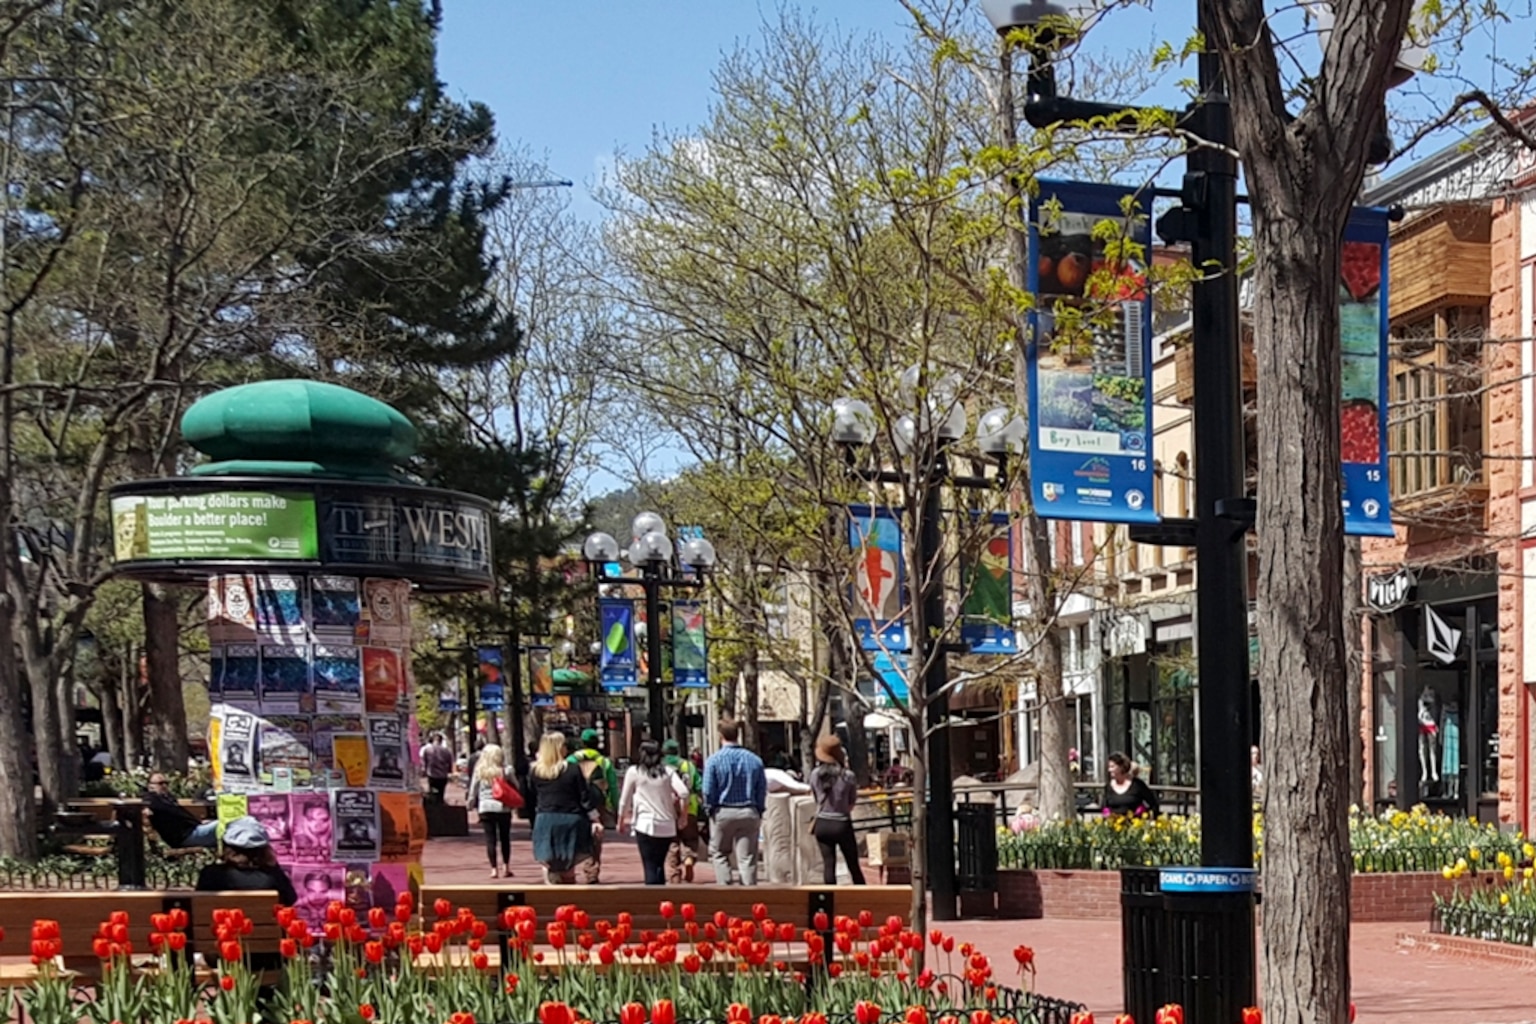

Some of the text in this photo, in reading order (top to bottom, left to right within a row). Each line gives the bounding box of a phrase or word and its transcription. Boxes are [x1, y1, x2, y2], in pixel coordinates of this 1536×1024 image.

[1131, 458, 1146, 471] 16
[1366, 470, 1381, 482] 15
[167, 496, 207, 510] parking
[207, 496, 249, 509] dollars
[252, 495, 287, 509] make
[148, 512, 268, 528] Boulder a better place!
[402, 505, 478, 550] WEST
[1197, 873, 1228, 886] PAPER
